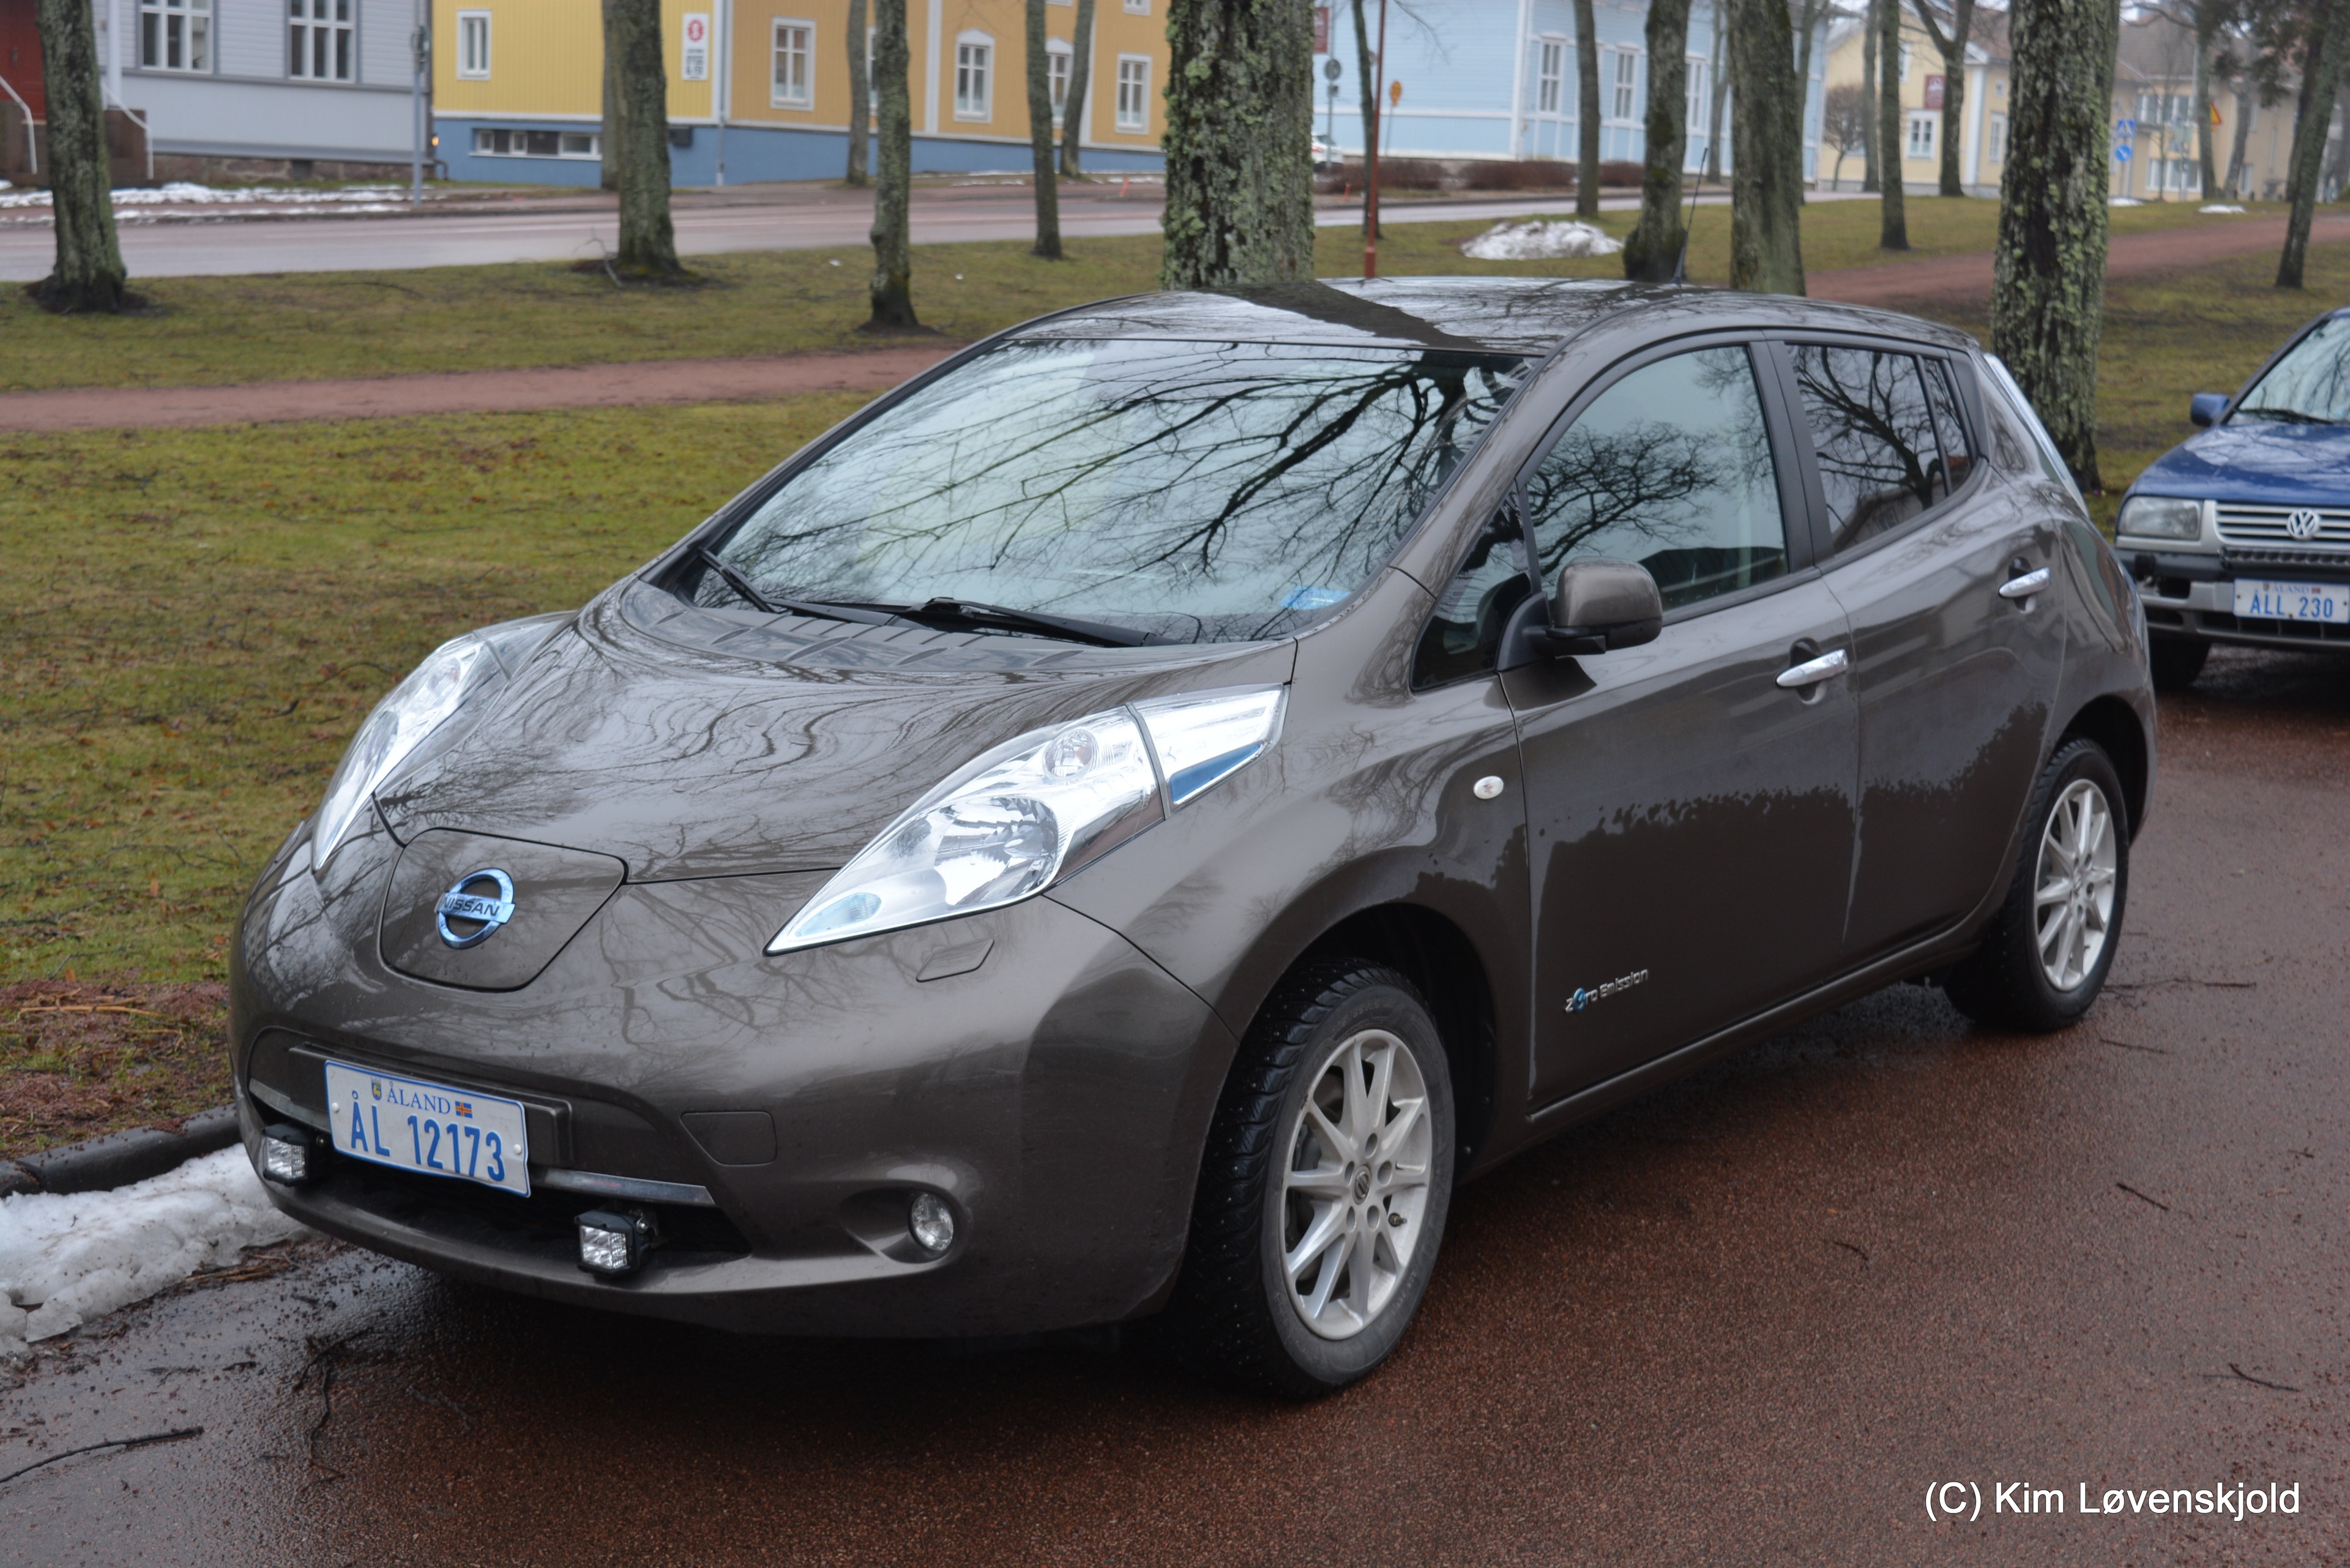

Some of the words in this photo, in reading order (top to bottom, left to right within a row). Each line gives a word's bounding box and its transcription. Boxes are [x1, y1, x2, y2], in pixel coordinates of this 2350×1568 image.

[2299, 596, 2333, 618] 230
[441, 897, 500, 917] NISSAN
[1600, 969, 1648, 998] Emission
[387, 1081, 451, 1114] ÅLAND
[351, 1090, 390, 1157] ÅL
[408, 1114, 505, 1182] 12173
